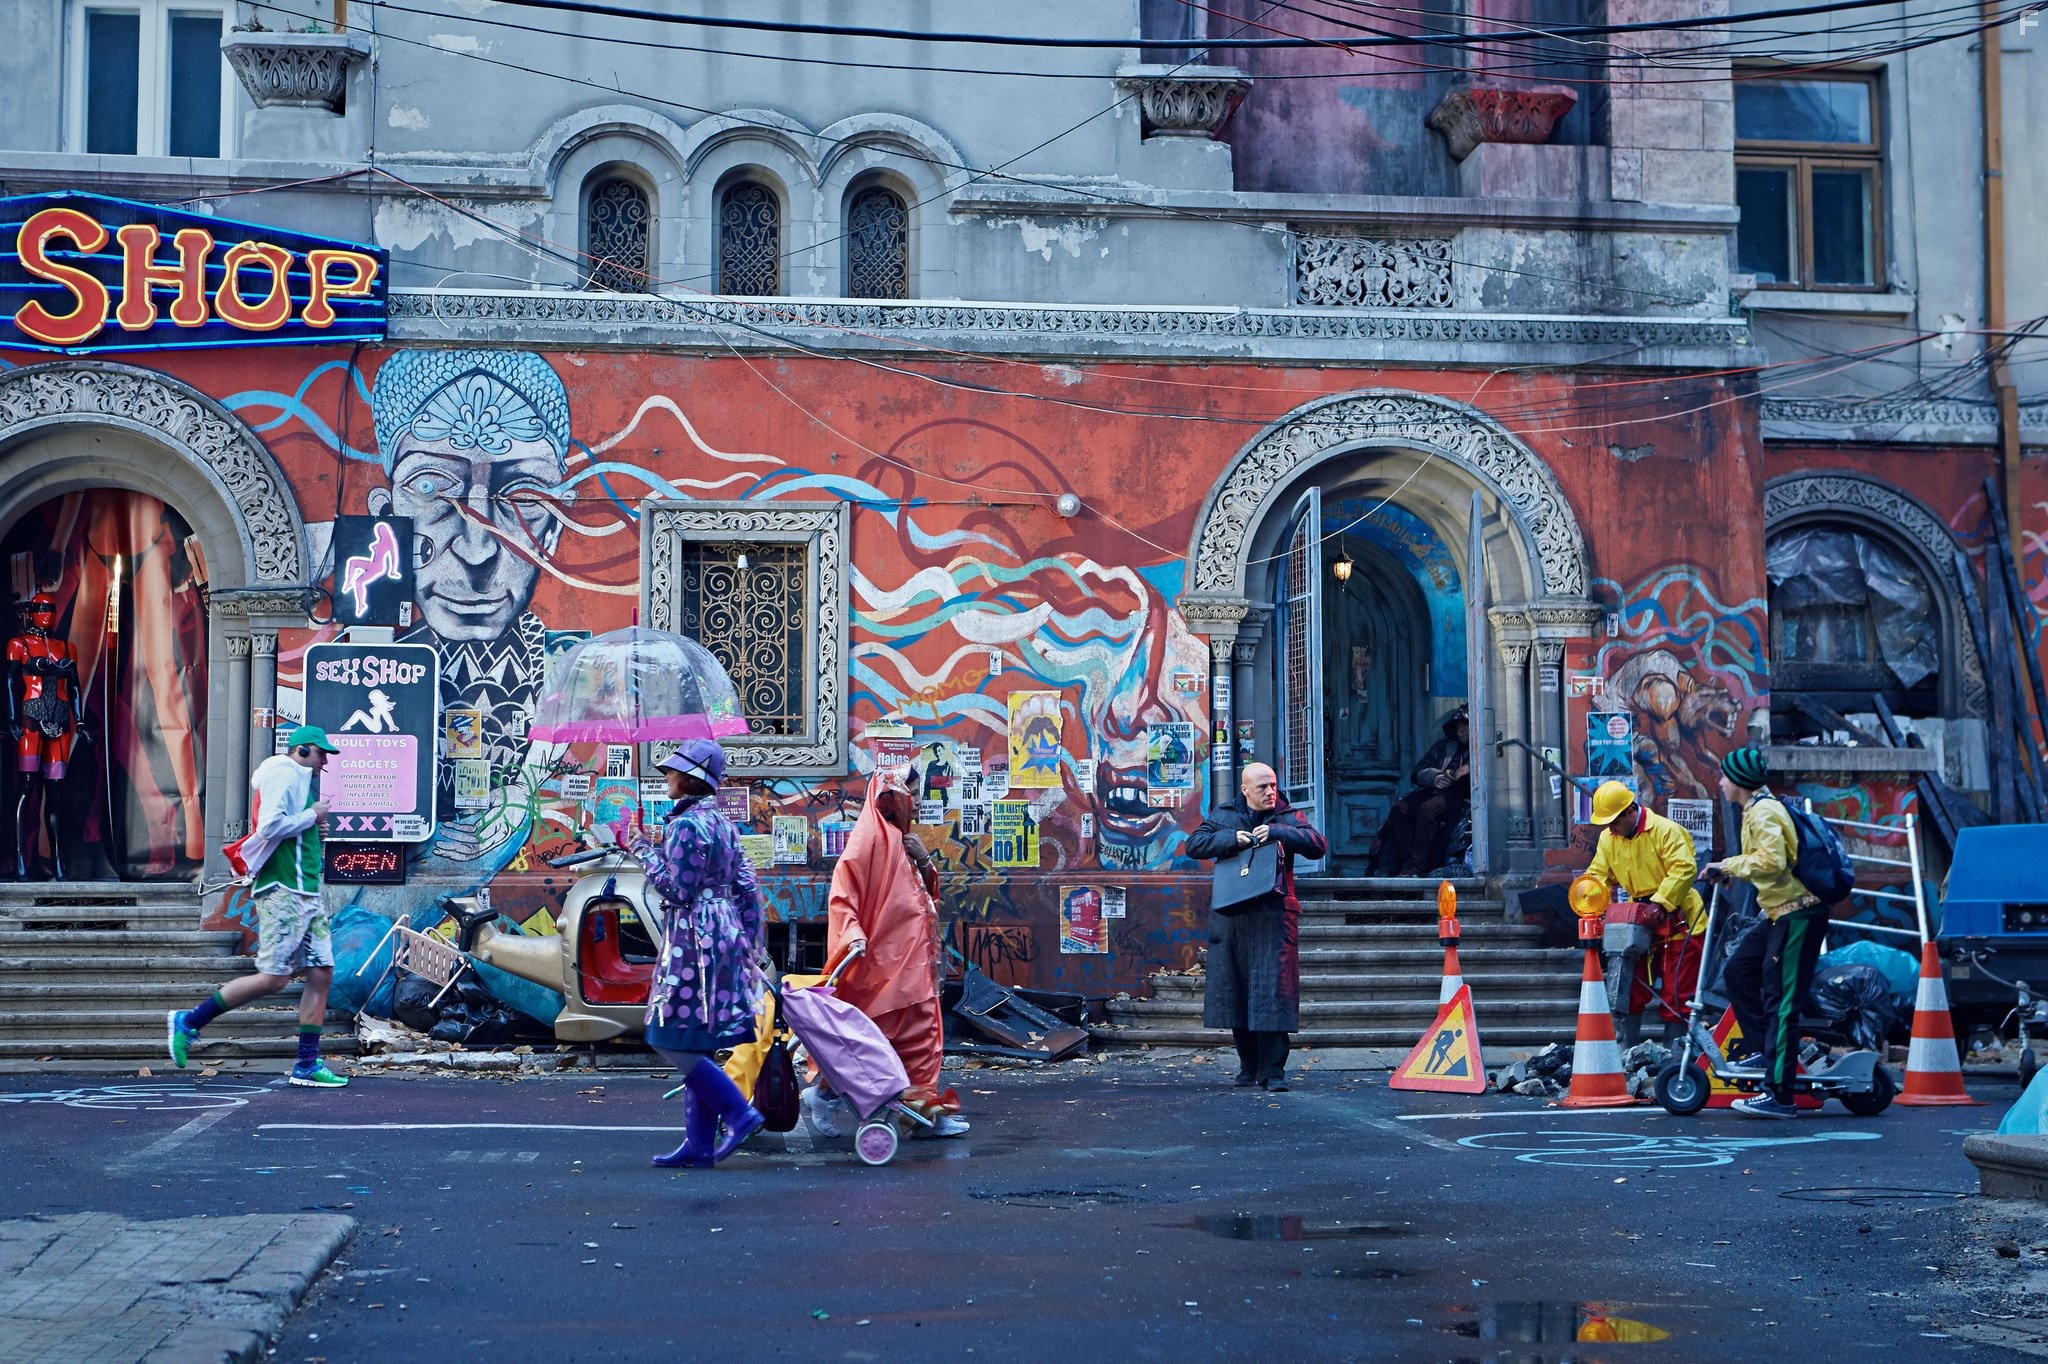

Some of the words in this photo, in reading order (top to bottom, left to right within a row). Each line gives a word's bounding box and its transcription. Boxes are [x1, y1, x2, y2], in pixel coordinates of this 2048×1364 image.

[14, 207, 378, 345] SHOP
[316, 657, 360, 686] SEX
[362, 655, 426, 688] SHOP
[333, 738, 372, 748] ADULT
[375, 738, 406, 748] TOYS
[341, 760, 398, 769] GADGETS
[878, 753, 910, 766] flakes
[1673, 810, 1687, 819] FEED
[1689, 810, 1707, 820] YOUR
[1673, 820, 1708, 831] URIOSITY
[994, 840, 1013, 862] no
[333, 854, 397, 872] OPEN
